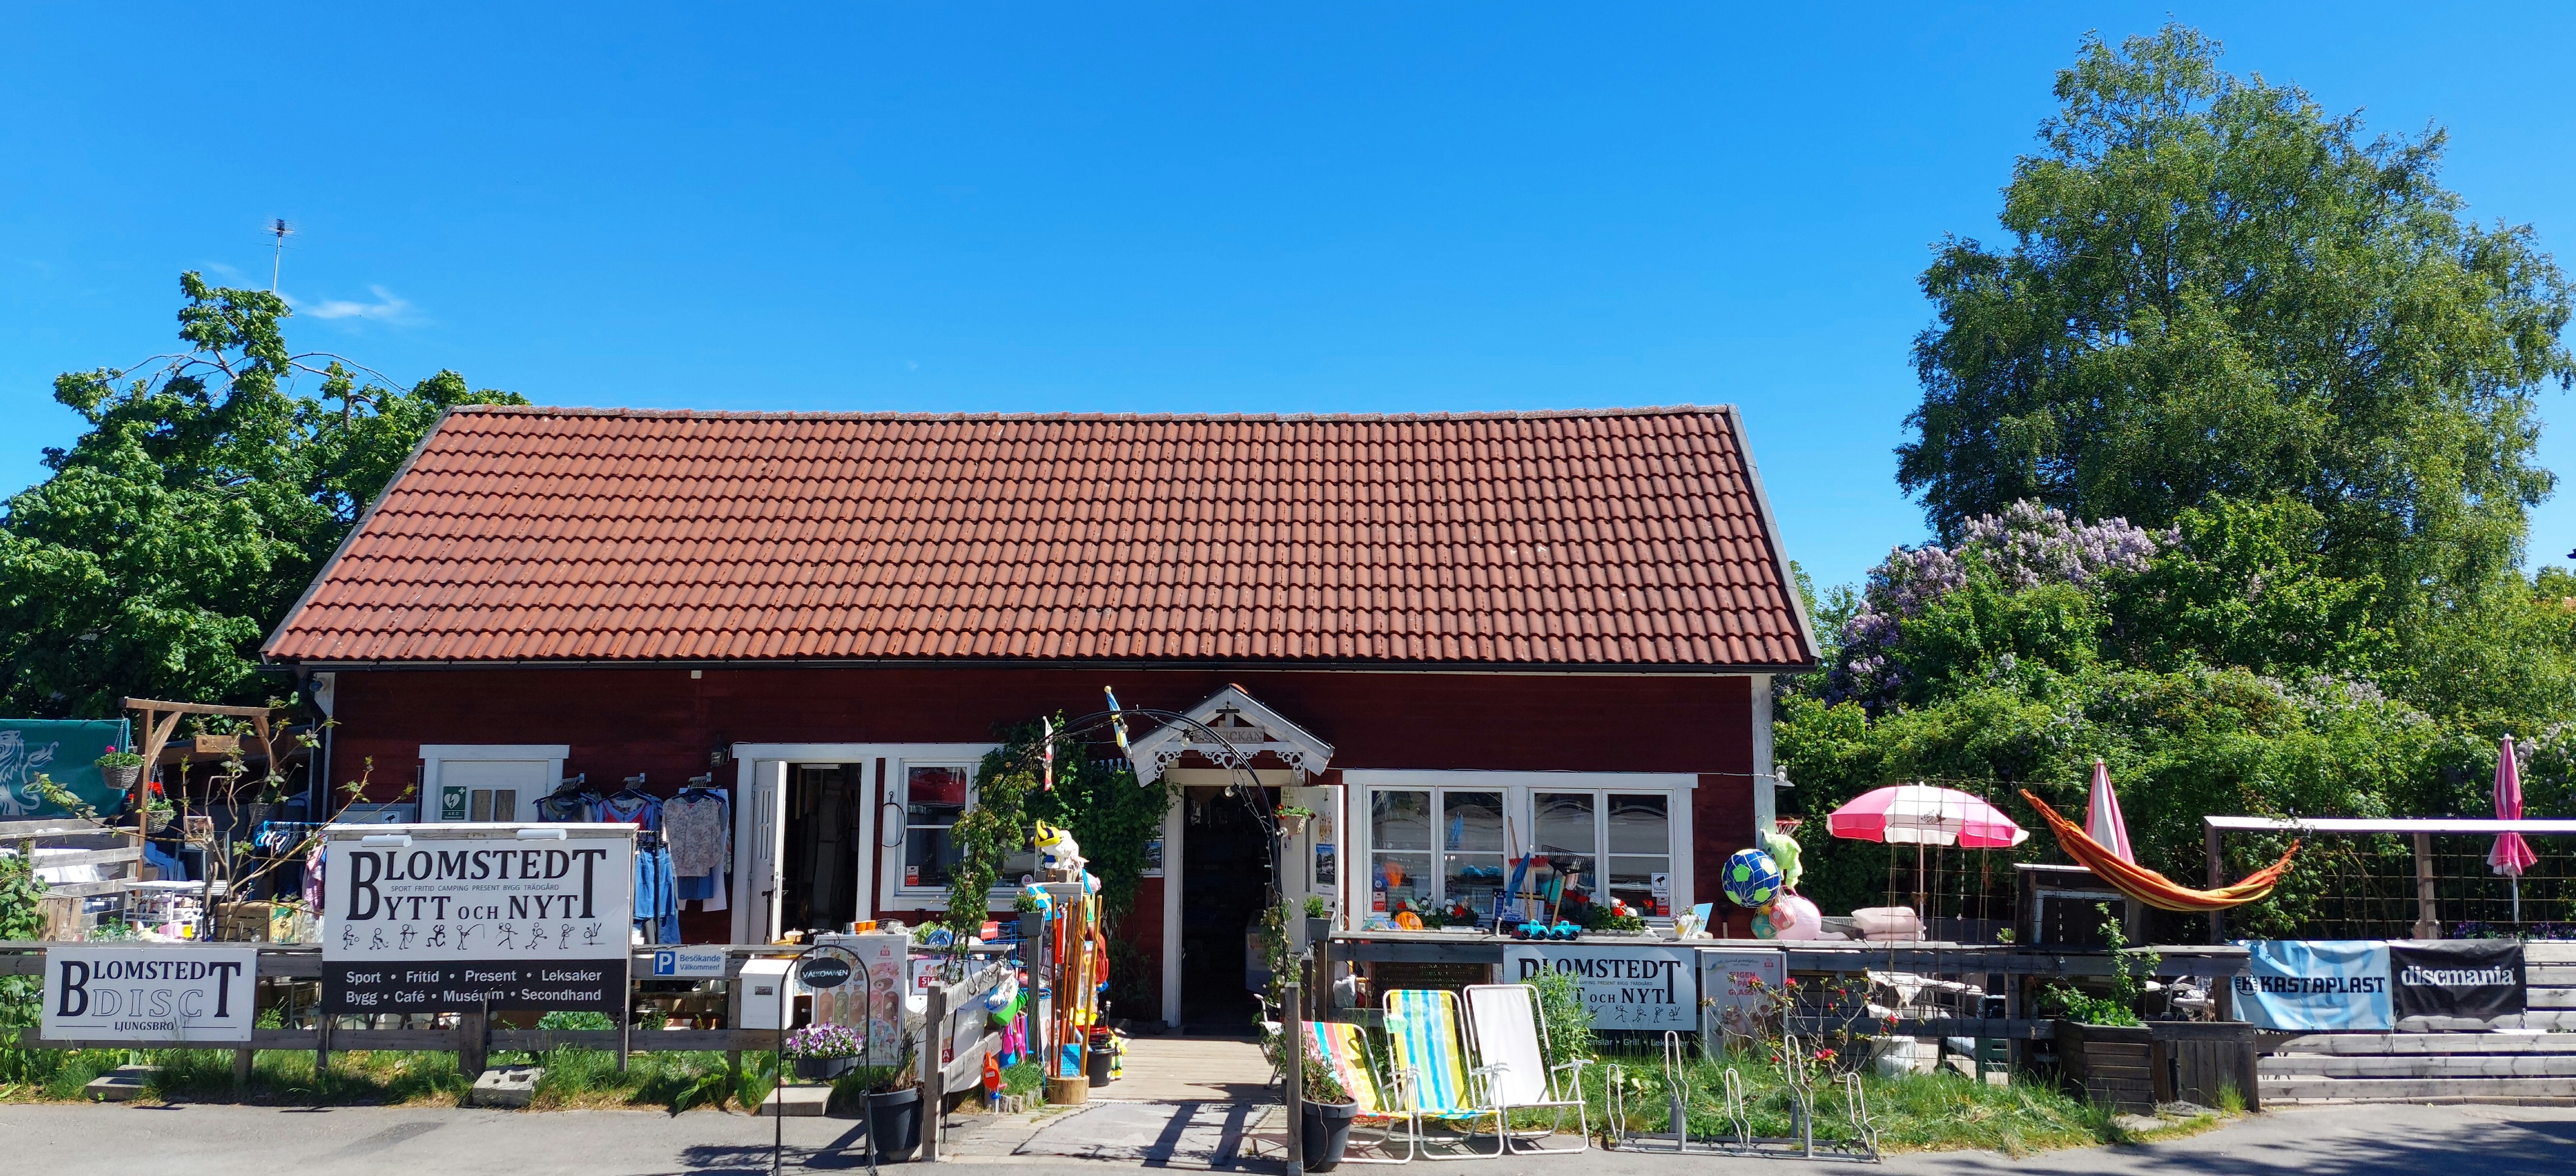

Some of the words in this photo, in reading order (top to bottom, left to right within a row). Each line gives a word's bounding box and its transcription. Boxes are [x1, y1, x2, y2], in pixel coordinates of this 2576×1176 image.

[523, 883, 559, 891] TRÄDGÅRD
[458, 906, 499, 920] OCH
[680, 954, 721, 962] Besökande
[346, 971, 381, 985] Sport
[406, 971, 439, 983] Fritid
[465, 970, 517, 982] Present
[542, 969, 602, 981] Leksaker
[802, 969, 849, 978] VÄLKOMMEN
[2402, 965, 2516, 985] discmania
[56, 961, 241, 1018] BLOMSTEDT
[2260, 977, 2385, 993] KASTAPLAST
[91, 989, 203, 1017] DISC
[346, 991, 378, 1005] Bygg
[395, 990, 425, 1002] Café
[443, 990, 504, 1002] Muséum
[521, 988, 602, 1001] Secondhand
[1589, 994, 1616, 1003] OCH
[114, 1021, 174, 1032] LJUNGSBRO
[1650, 1038, 1688, 1047] Lekaer
